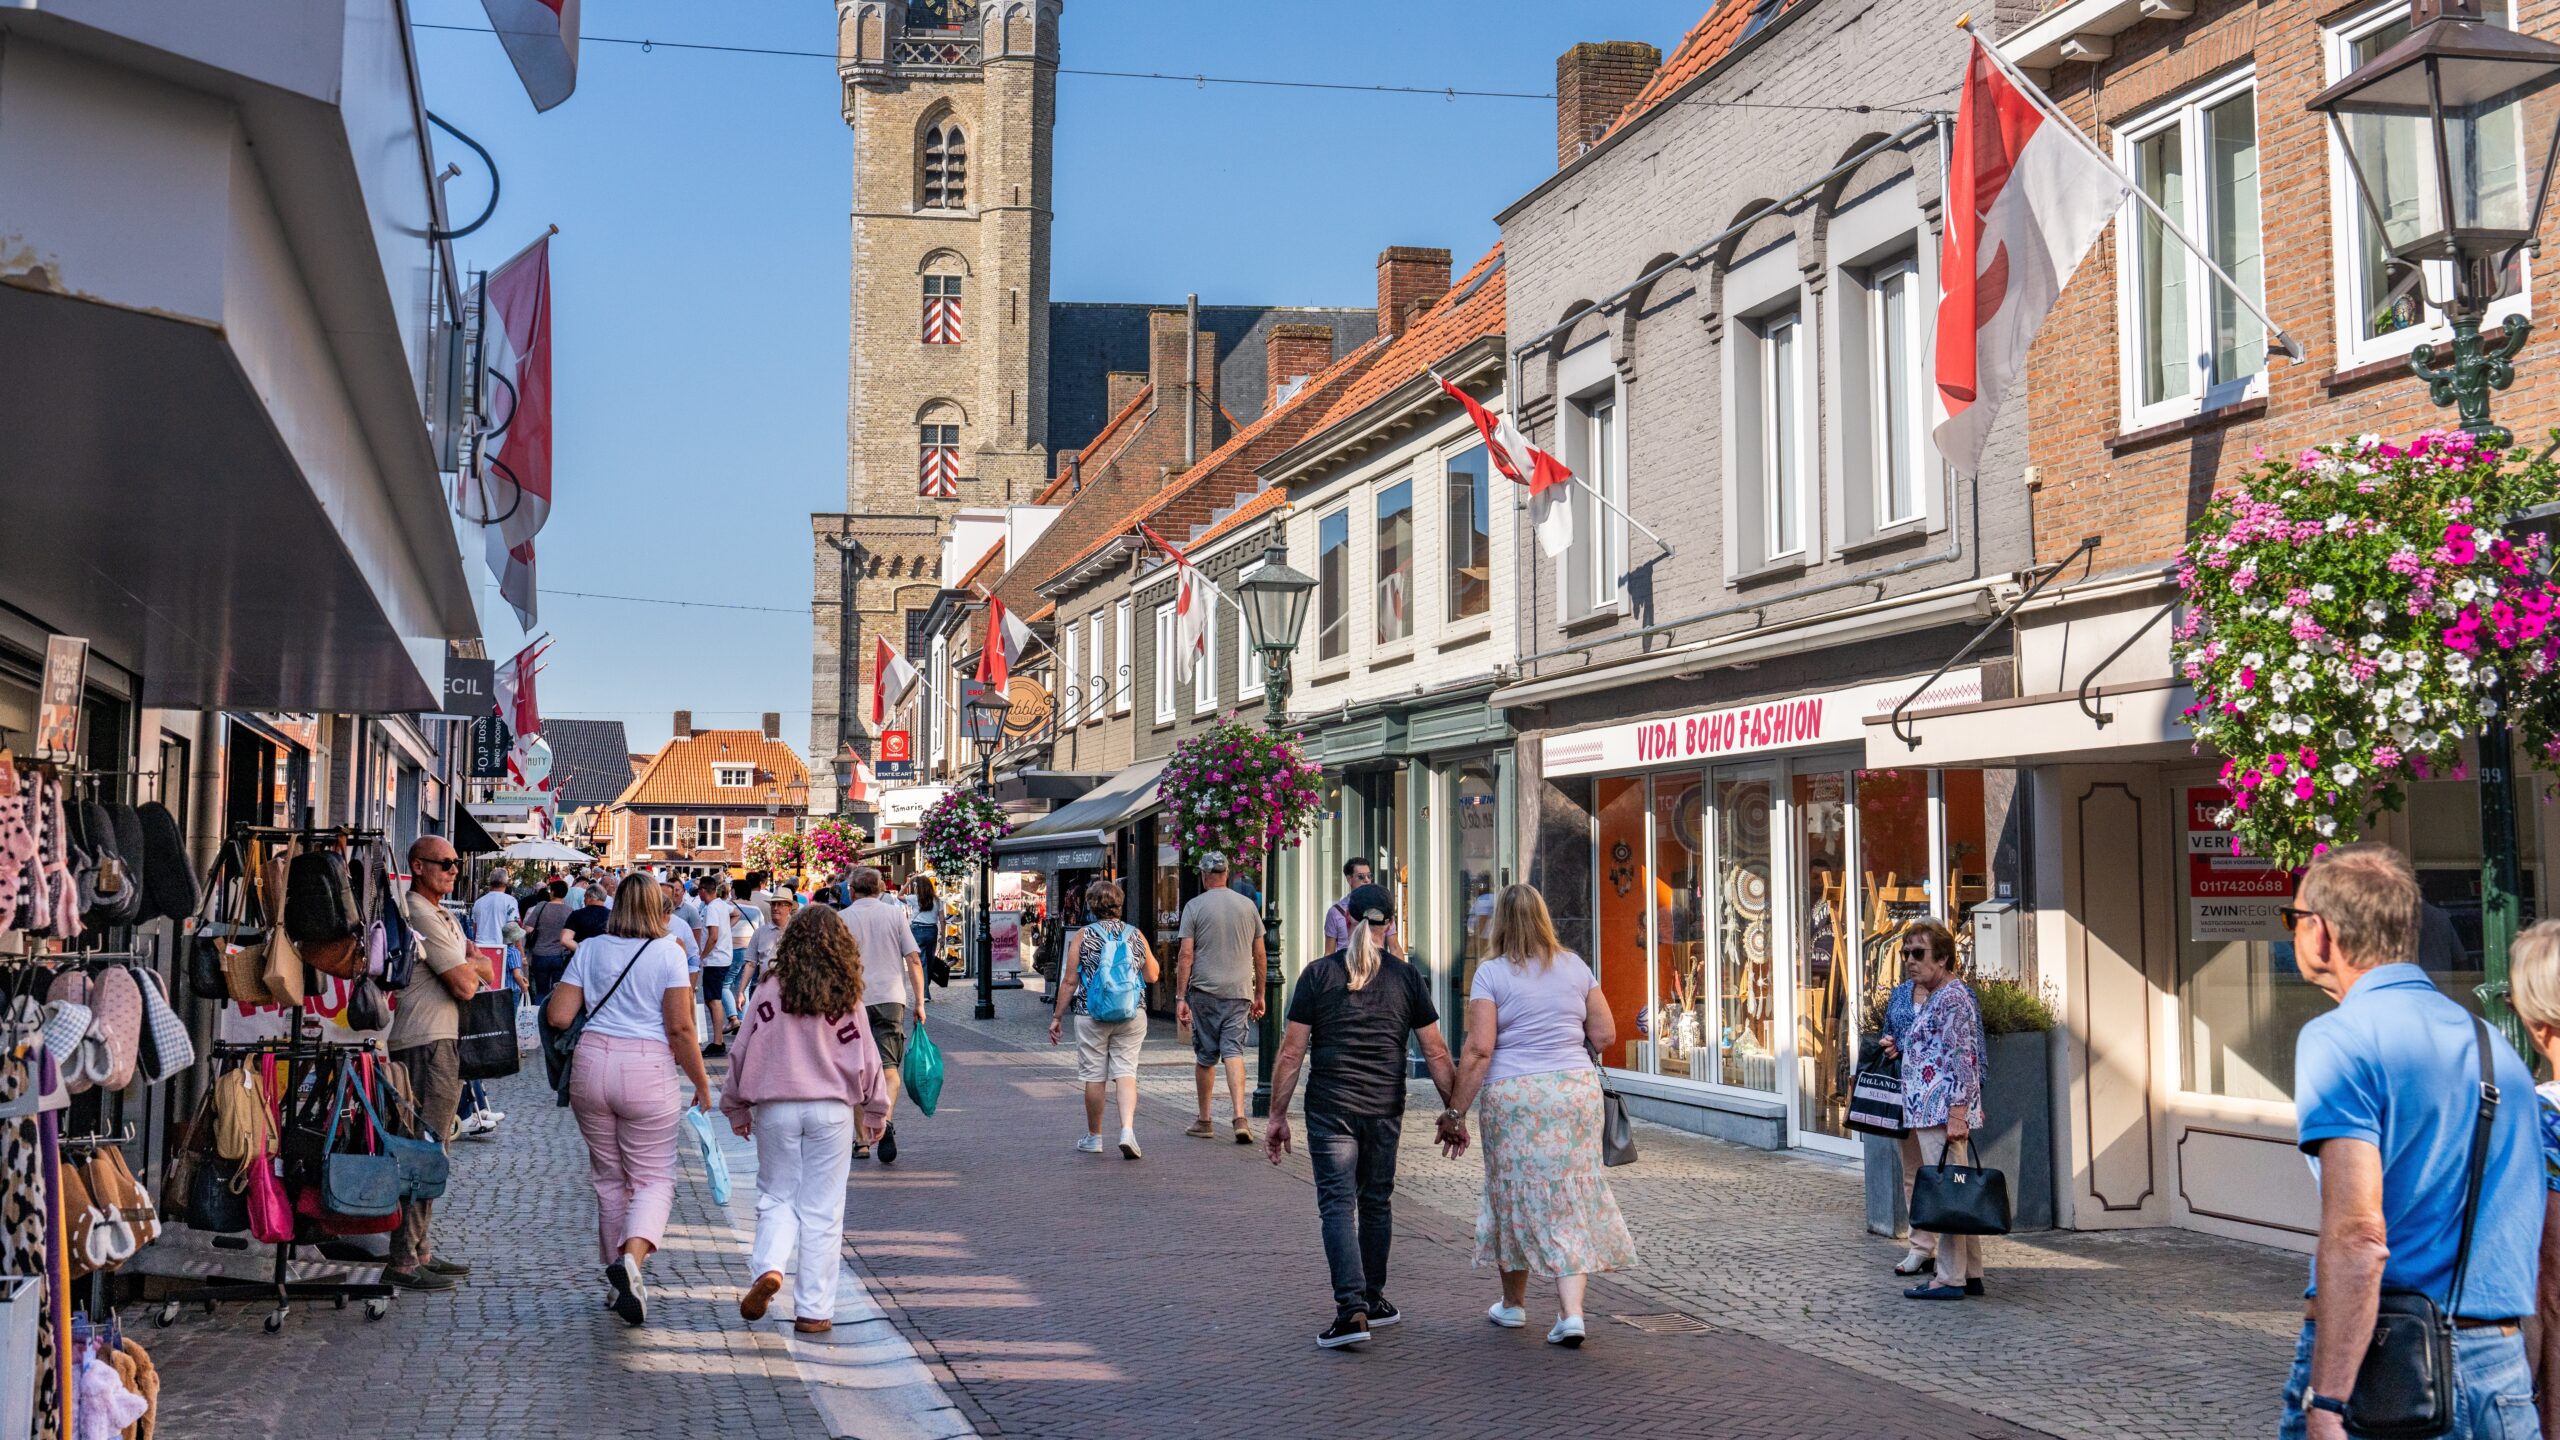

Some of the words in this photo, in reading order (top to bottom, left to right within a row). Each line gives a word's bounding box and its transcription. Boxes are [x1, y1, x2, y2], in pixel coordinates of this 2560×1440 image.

[53, 653, 79, 671] HOME
[52, 668, 77, 686] WEAR
[444, 677, 483, 696] ECIL
[478, 716, 490, 743] isson
[1637, 722, 1677, 761] VIDA
[1686, 712, 1735, 756] BOHO
[1739, 698, 1823, 749] FASHION
[477, 747, 489, 773] d'Or
[2481, 768, 2501, 783] 99
[891, 802, 924, 813] Tamaris
[2191, 836, 2233, 848] VERK
[2200, 881, 2283, 892] 0117420688
[1869, 1090, 1887, 1099] SLUIS
